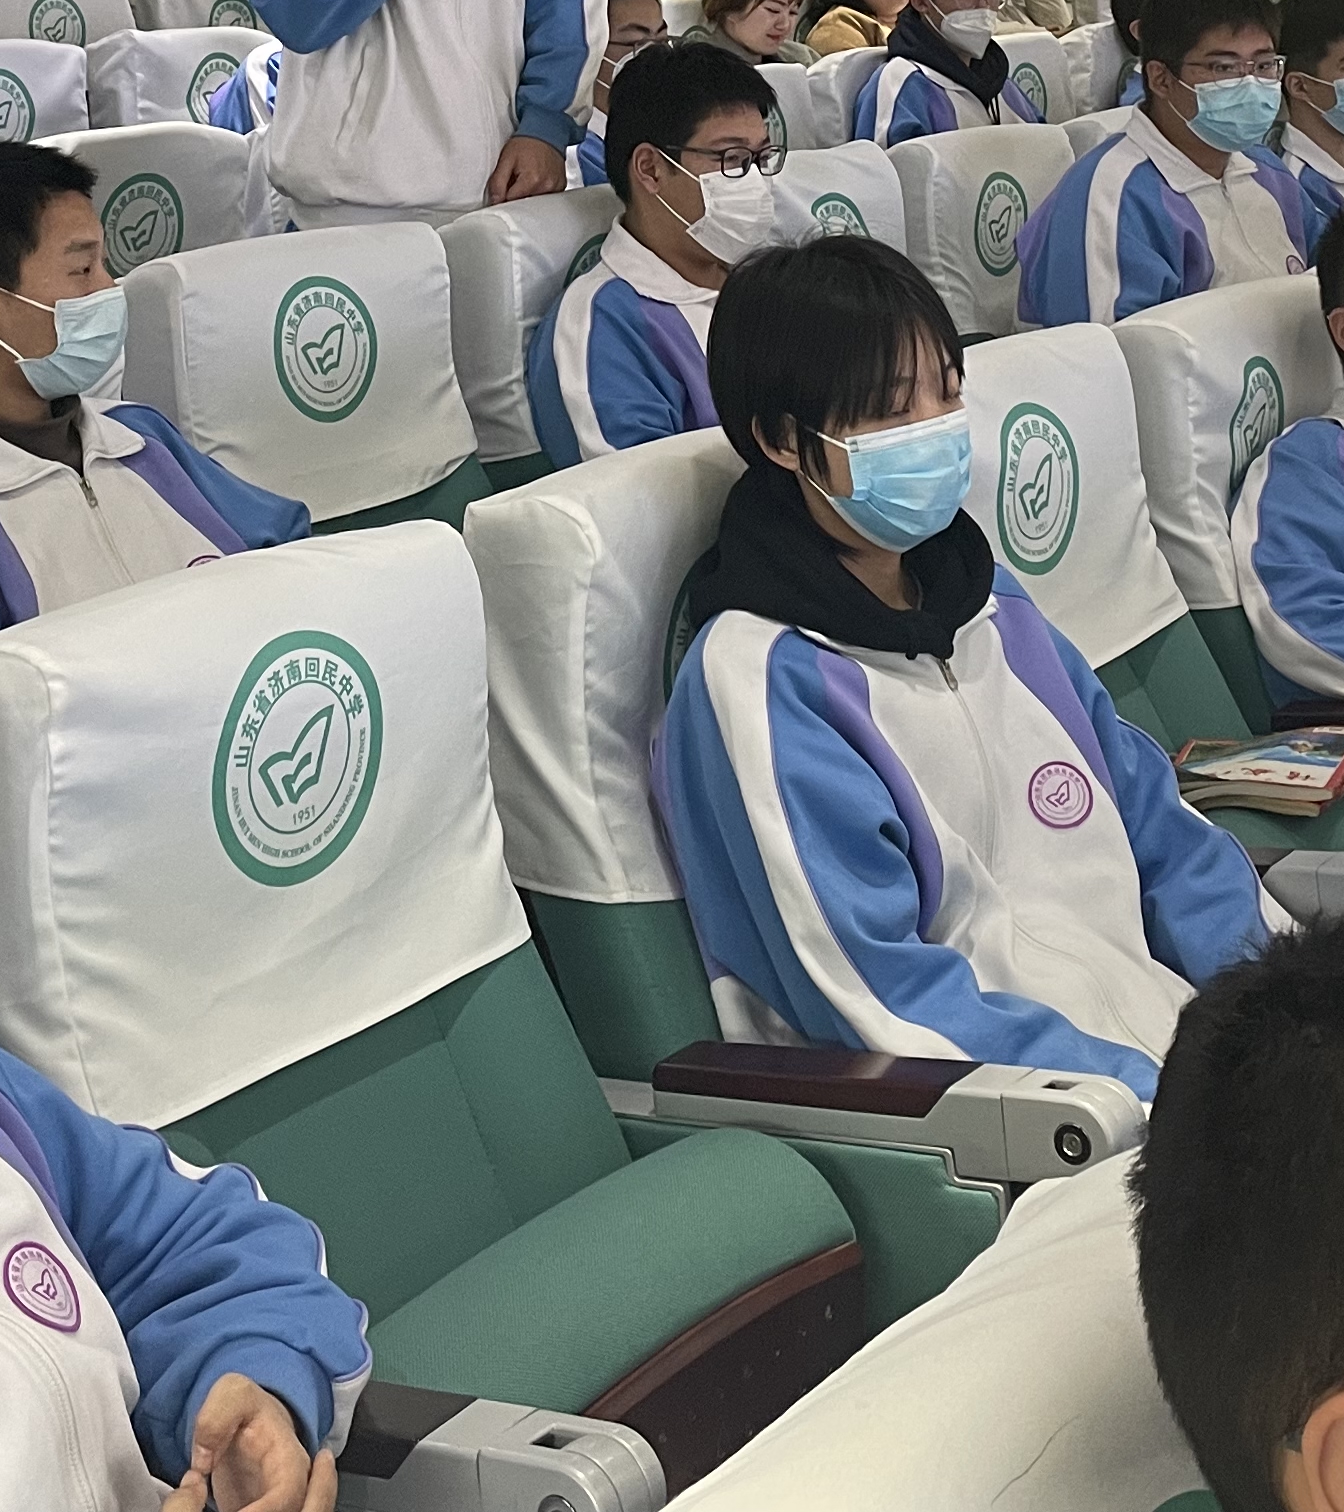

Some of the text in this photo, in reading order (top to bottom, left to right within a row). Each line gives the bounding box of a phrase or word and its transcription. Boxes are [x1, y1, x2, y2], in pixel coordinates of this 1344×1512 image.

[233, 656, 366, 769] 山东省济南回民中学
[291, 804, 317, 826] 1951
